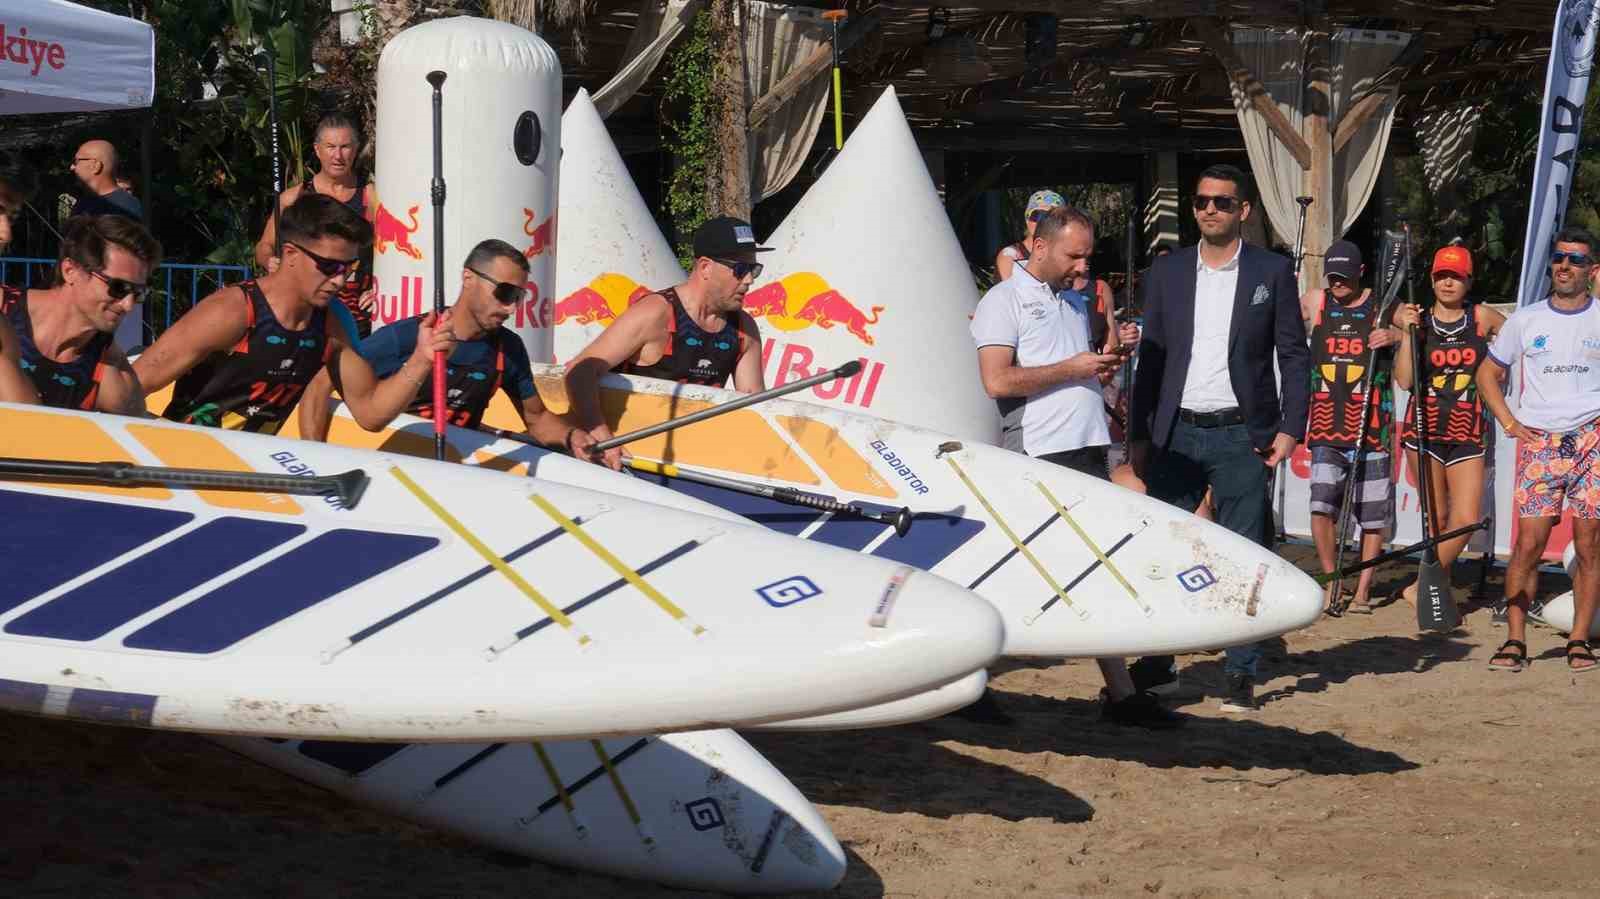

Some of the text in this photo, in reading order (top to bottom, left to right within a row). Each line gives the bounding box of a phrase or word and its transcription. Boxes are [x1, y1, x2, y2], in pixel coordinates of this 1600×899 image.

[1325, 337, 1364, 355] 136
[1430, 347, 1476, 367] 009
[772, 342, 886, 409] Bull
